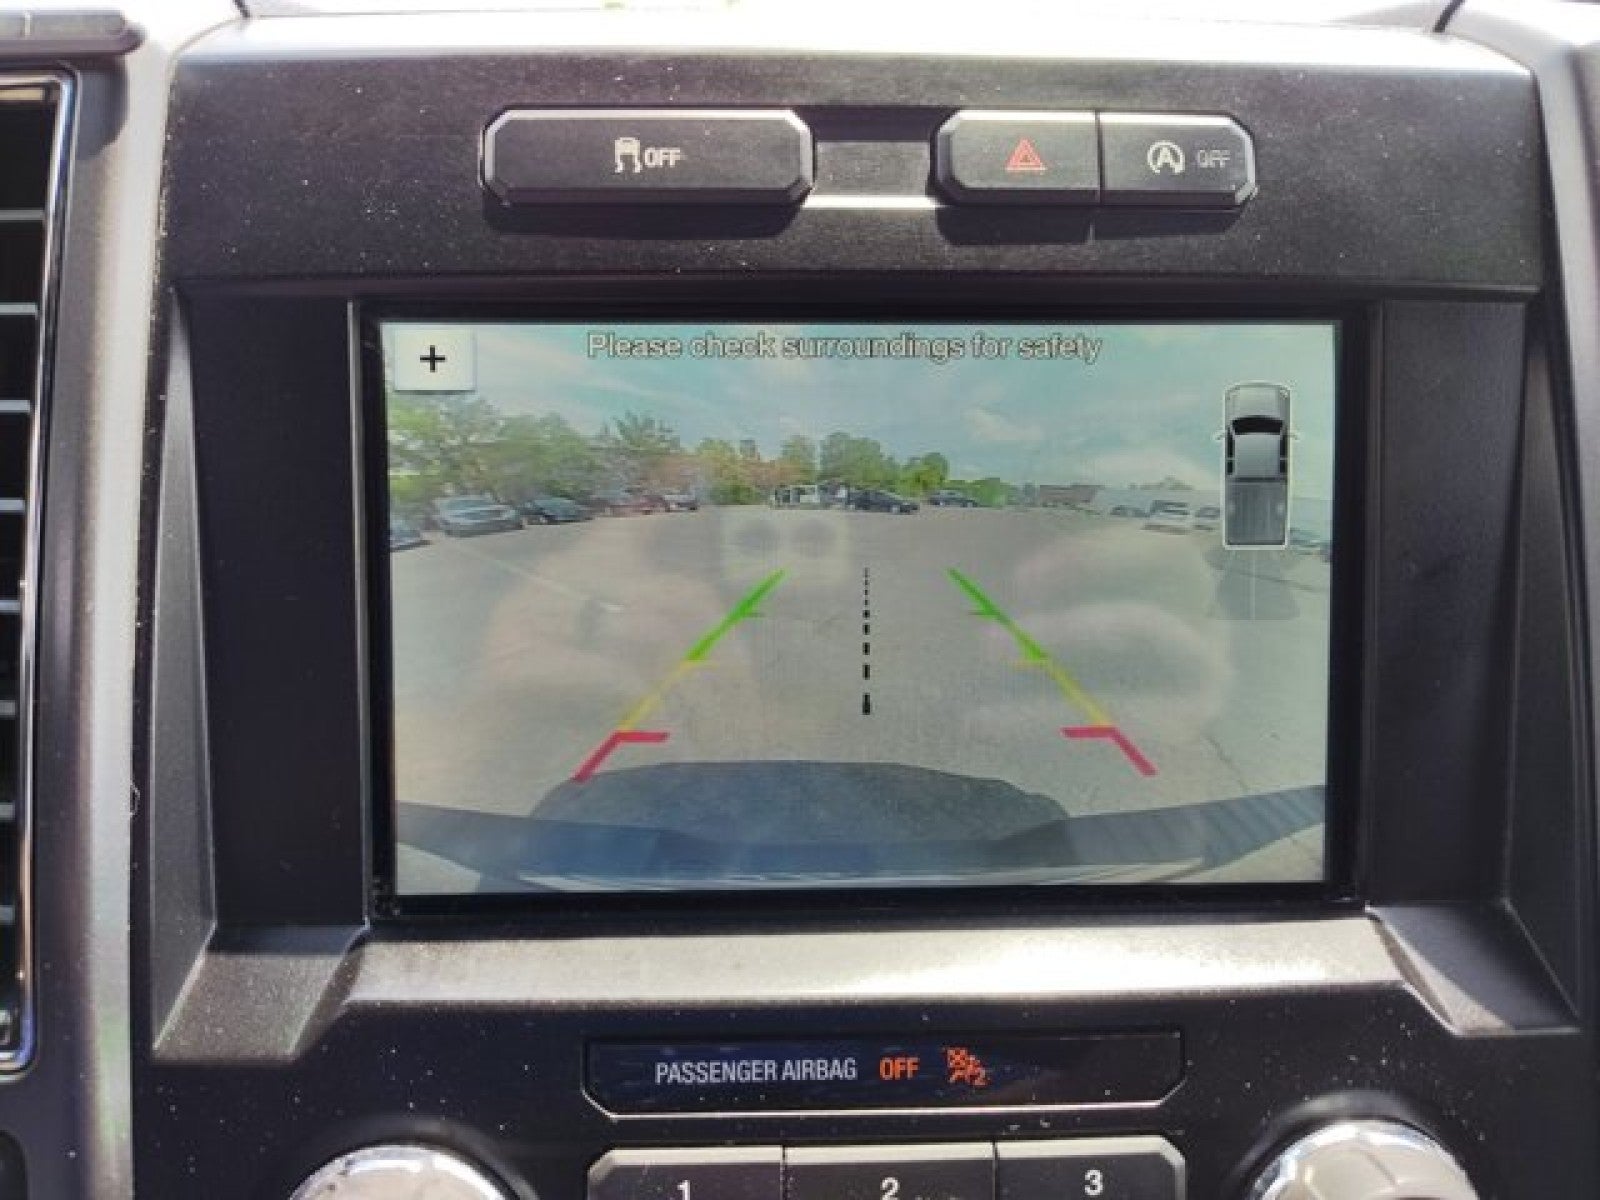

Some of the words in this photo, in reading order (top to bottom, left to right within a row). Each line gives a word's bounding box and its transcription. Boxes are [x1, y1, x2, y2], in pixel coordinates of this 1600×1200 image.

[644, 147, 681, 168] OFF
[1197, 149, 1230, 169] OFF
[587, 331, 683, 359] Please
[691, 331, 776, 359] check
[781, 331, 965, 364] surroundings
[970, 331, 1011, 360] for
[1016, 331, 1103, 364] safety
[654, 1060, 779, 1085] PASSENGER
[782, 1057, 858, 1082] AIRBAG
[879, 1057, 920, 1081] OFF
[676, 1179, 691, 1200] 1
[881, 1176, 899, 1200] 2
[1084, 1169, 1104, 1196] 3
